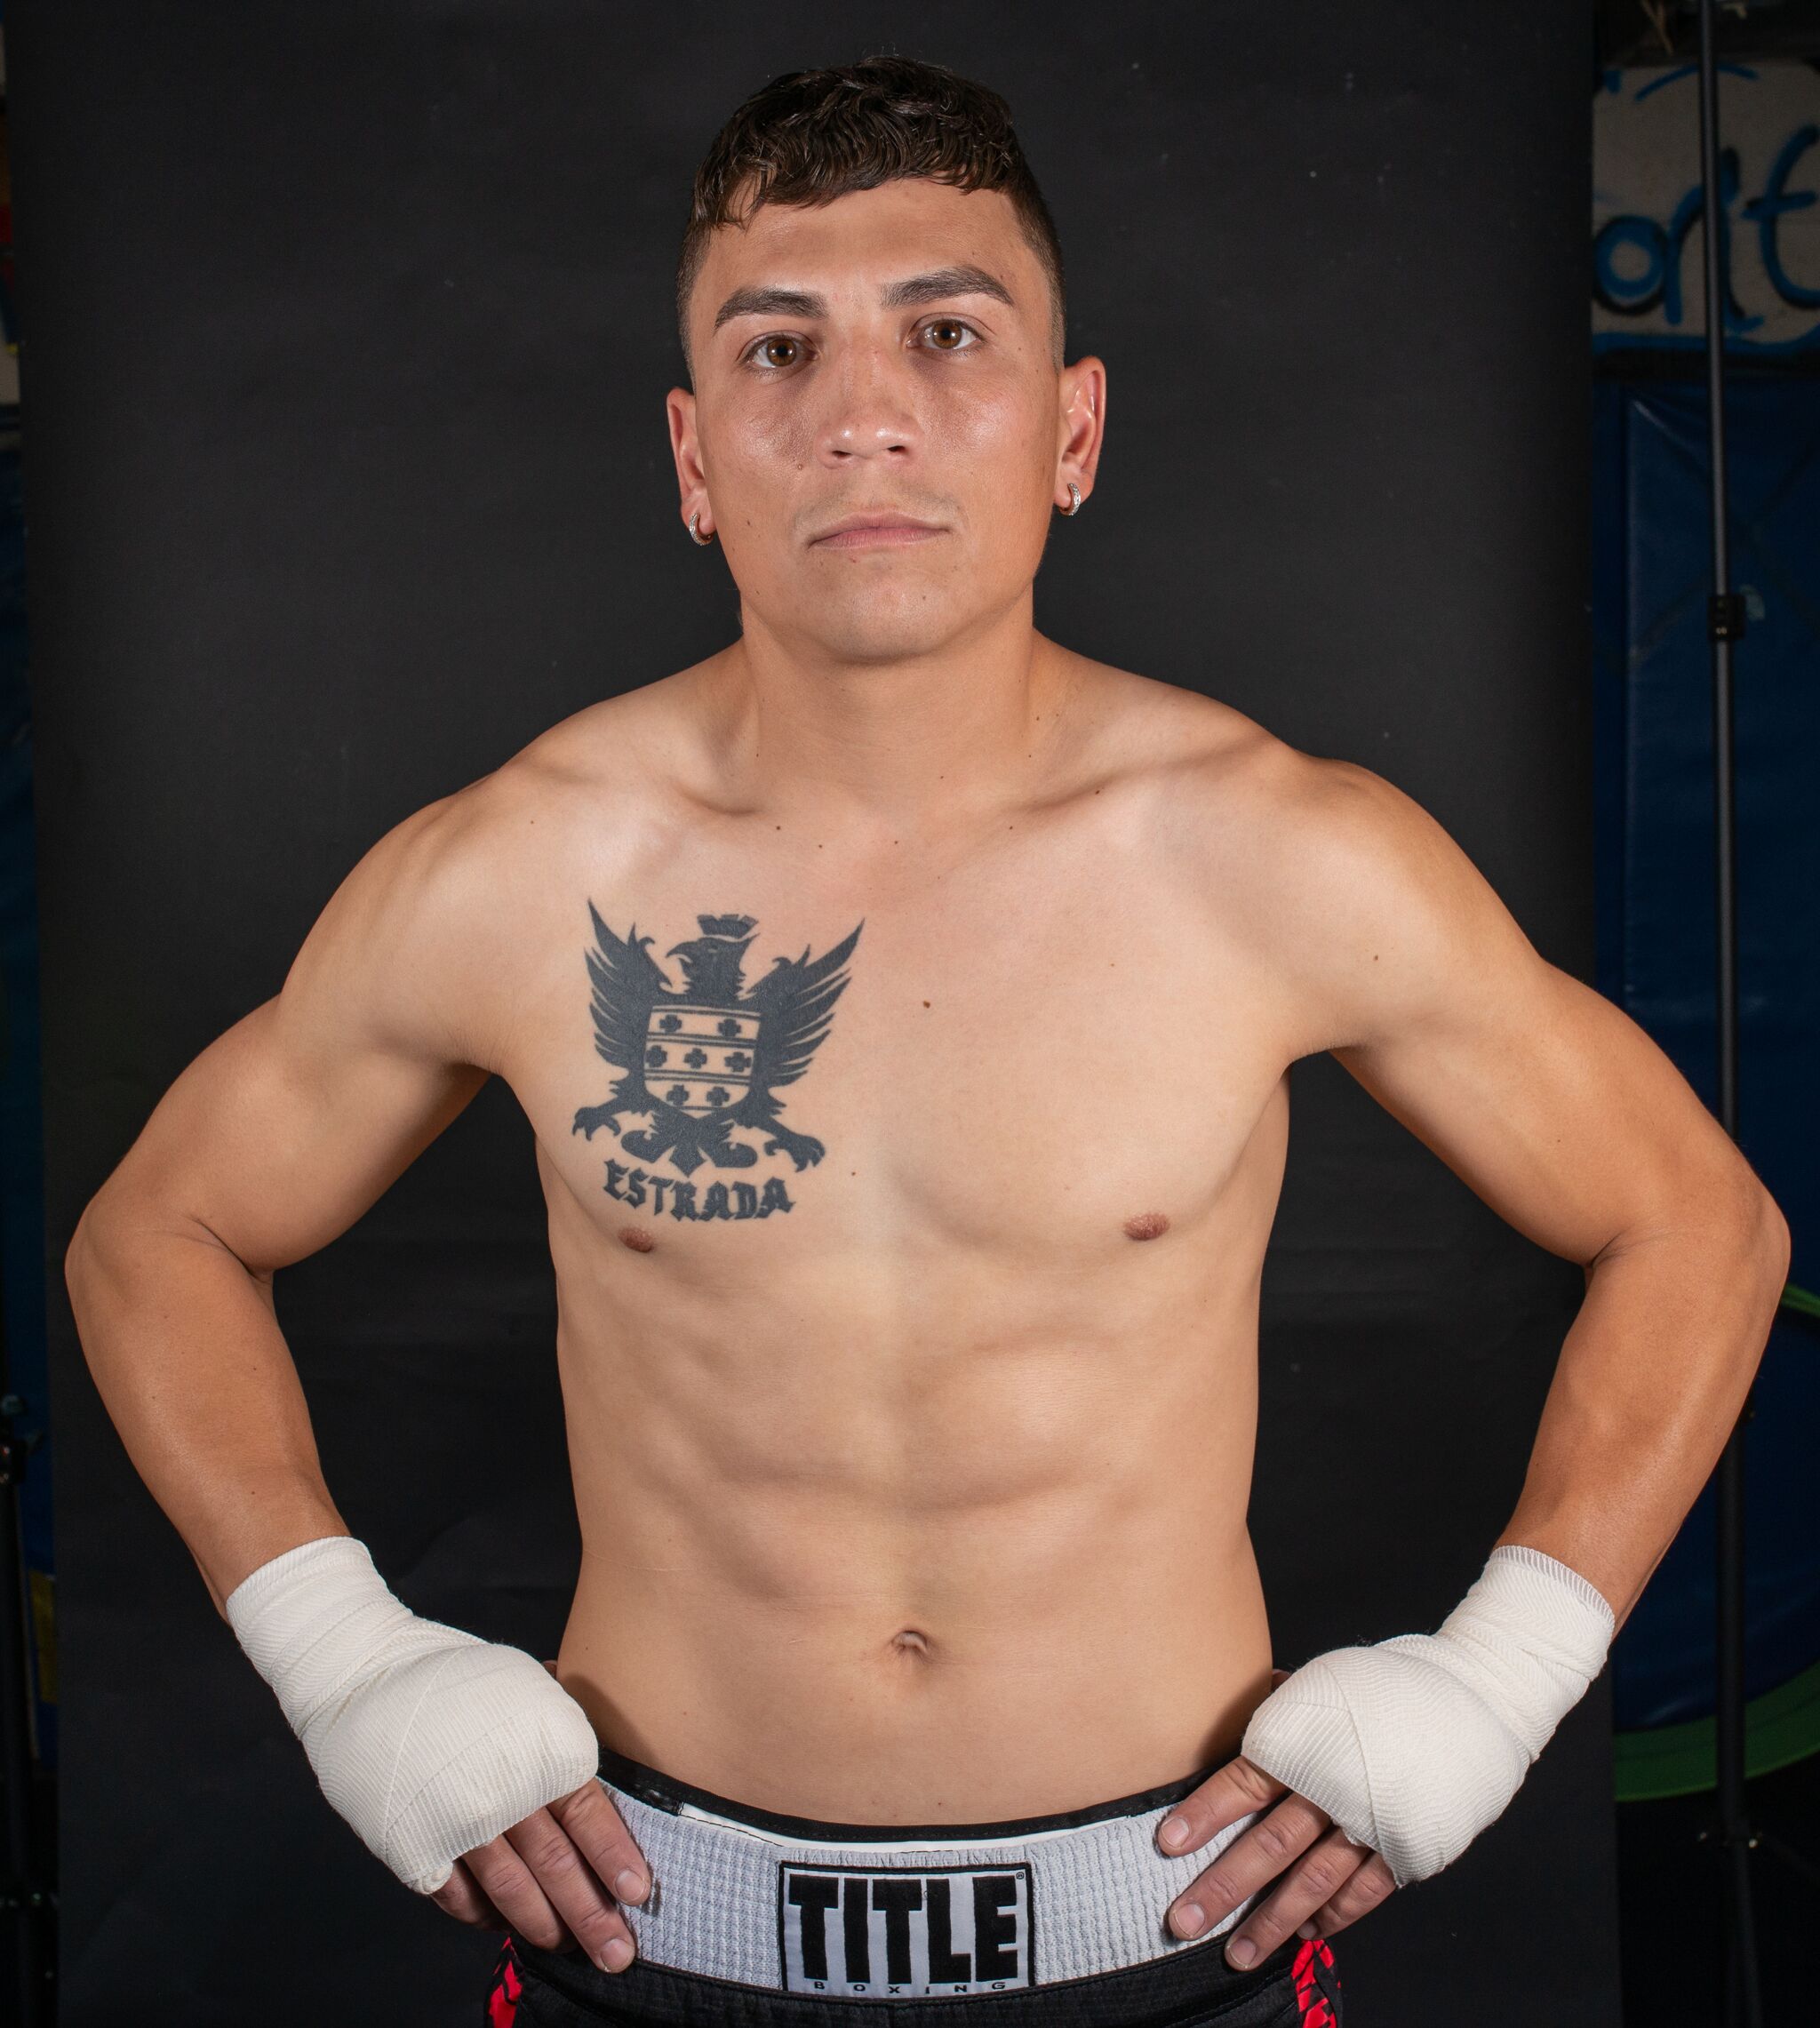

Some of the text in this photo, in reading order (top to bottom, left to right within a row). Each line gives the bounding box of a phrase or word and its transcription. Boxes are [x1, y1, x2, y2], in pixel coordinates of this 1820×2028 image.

[603, 1158, 796, 1222] ESTRADA
[788, 1873, 1018, 1984] TITLE
[813, 1981, 1006, 1995] BOXING
